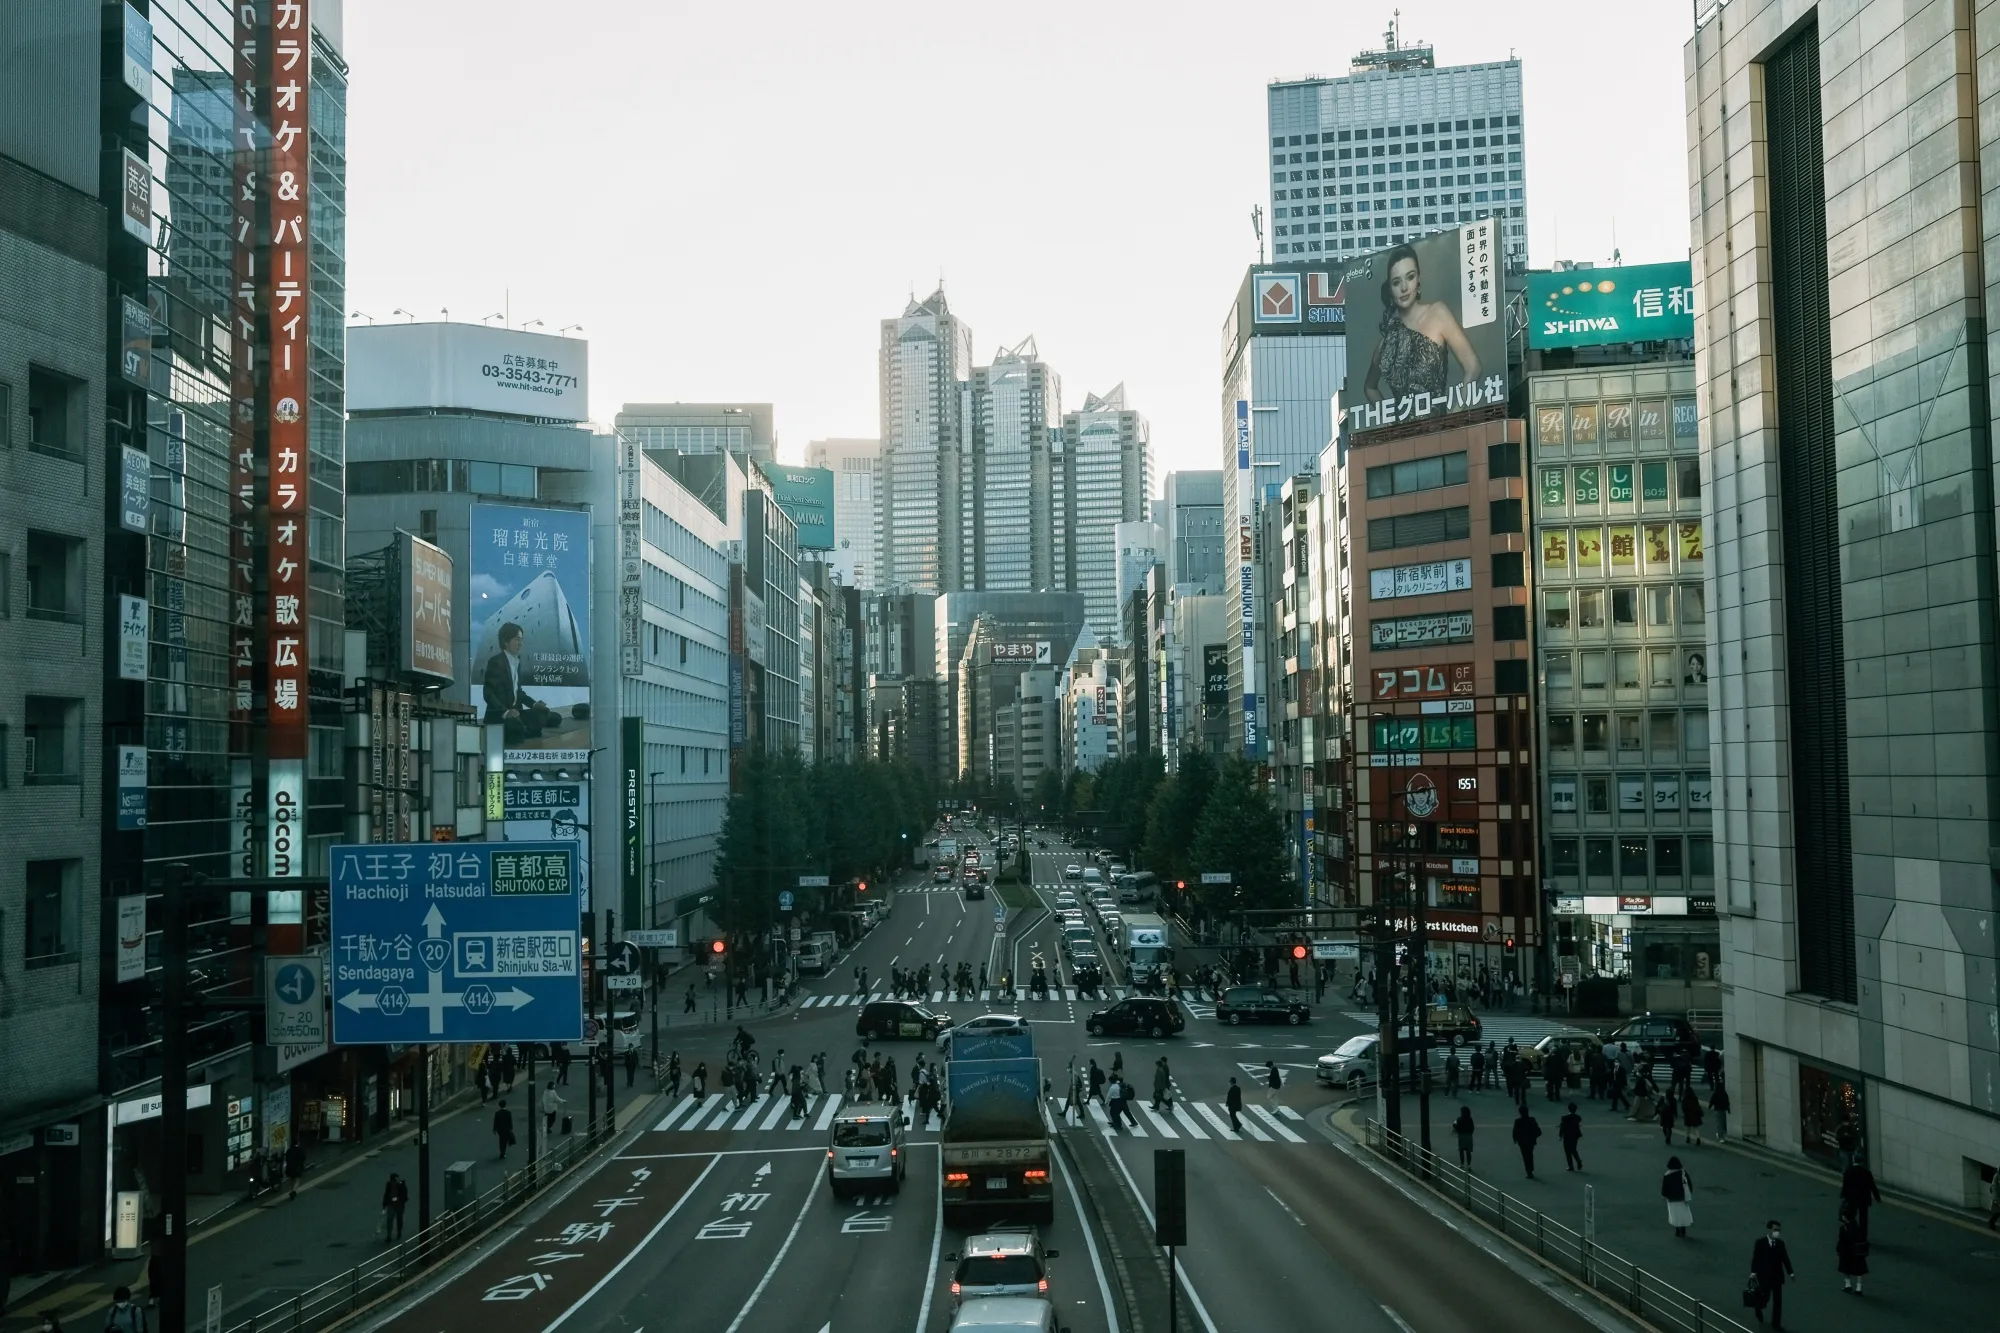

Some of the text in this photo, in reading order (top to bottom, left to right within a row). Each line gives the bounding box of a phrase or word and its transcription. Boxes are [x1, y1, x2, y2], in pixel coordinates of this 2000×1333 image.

[127, 166, 149, 204] 茜会
[1466, 229, 1476, 298] 面白くする。
[1478, 226, 1489, 317] 世界の不動産を
[1346, 266, 1366, 283] global
[1632, 286, 1694, 319] 信和
[125, 302, 150, 327] 海外旅行
[1308, 308, 1345, 323] SHIN
[503, 354, 558, 371] 広告募集中
[482, 364, 577, 388] 03-3543-7771
[497, 380, 562, 396] www.hit-ad.co.jp
[1349, 375, 1504, 430] THEグローバル社
[125, 451, 147, 472] AEON
[125, 474, 147, 494] 英会話
[124, 494, 149, 510] イーオン
[622, 501, 640, 510] 共立
[523, 518, 538, 528] 新宿
[796, 512, 825, 526] MIWA
[493, 529, 568, 551] 瑠璃光院
[1240, 527, 1252, 562] LABI
[503, 551, 557, 568] 白蓮華堂
[274, 447, 299, 710] カラオケ歌広場
[1396, 563, 1445, 584] 新宿駅前
[1454, 562, 1465, 587] 歯科
[1241, 566, 1253, 618] SHINJUKU
[1379, 579, 1447, 597] デンタルクリニック
[123, 621, 147, 638] テイケイ
[1398, 623, 1472, 641] エーアイアール
[533, 652, 584, 663] 生涯最良の選択
[994, 644, 1033, 656] やまや
[533, 664, 579, 674] ワンランク上の
[1456, 667, 1470, 679] 6F
[1378, 667, 1446, 696] アコム
[1451, 702, 1472, 711] アコム
[1247, 722, 1257, 745] LABI
[275, 790, 291, 877] docom
[339, 852, 567, 881] 八王子 初台 首都高
[346, 880, 568, 902] Hachioji Hatsudai SHUTOKO EXP
[1441, 921, 1478, 933] Kitchen
[426, 945, 444, 960] 20
[497, 935, 572, 959] 新宿駅西口
[338, 966, 415, 983] Sendagaya
[497, 961, 539, 975] Shinjuku
[382, 993, 404, 1008] 414
[468, 992, 490, 1007] 414
[272, 1025, 320, 1037] この先50m
[963, 1040, 988, 1055] Potential
[999, 1038, 1022, 1054] Infinity
[991, 1075, 1000, 1083] of
[1002, 1074, 1032, 1093] Infinity
[961, 1148, 1030, 1159] 品川 2872
